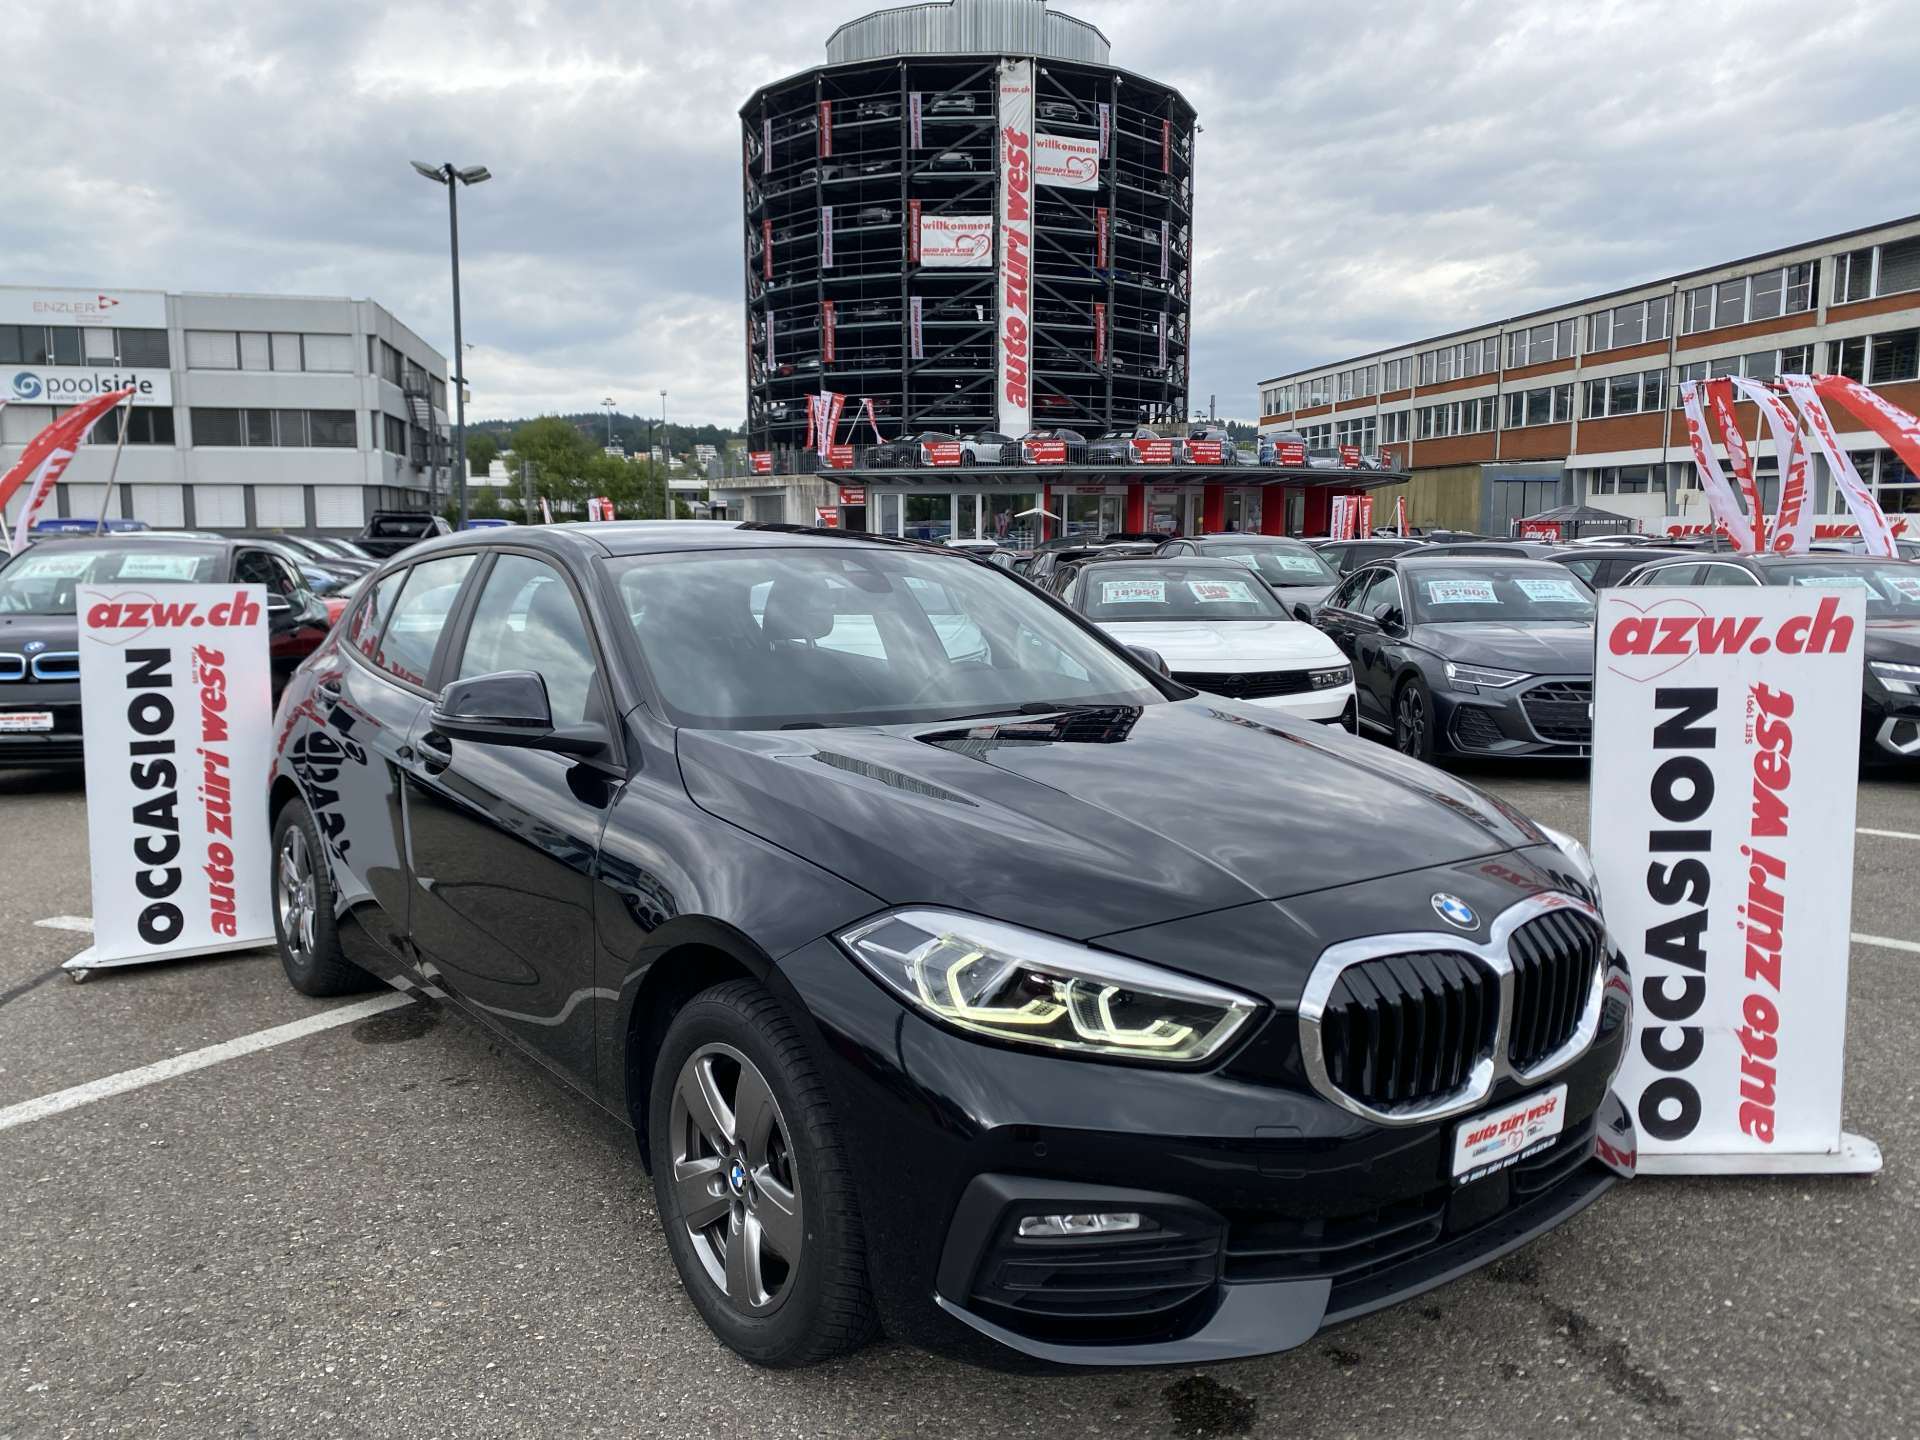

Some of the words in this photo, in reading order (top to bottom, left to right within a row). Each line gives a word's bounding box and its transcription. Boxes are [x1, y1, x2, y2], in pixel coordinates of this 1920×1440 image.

[1004, 126, 1030, 221] west
[1036, 139, 1098, 154] willkommen
[922, 220, 991, 230] willkommen
[1001, 224, 1029, 316] züri
[32, 301, 96, 313] ENZLER
[46, 373, 153, 399] poolside
[1002, 316, 1028, 409] auto
[87, 591, 260, 629] azw.ch
[1608, 597, 1855, 656] azw.ch
[192, 644, 229, 742] west
[1744, 723, 1753, 745] SEIT
[1745, 694, 1755, 719] 1991
[125, 648, 184, 945] OCCASION
[196, 747, 233, 840] züri
[1749, 681, 1795, 837] west
[201, 842, 237, 937] auto
[1638, 687, 1719, 1141] OCCASION
[1736, 844, 1787, 992] züri
[1733, 993, 1780, 1144] auto
[1465, 1124, 1498, 1148] auto
[1499, 1109, 1529, 1134] züri
[1527, 1097, 1557, 1122] west
